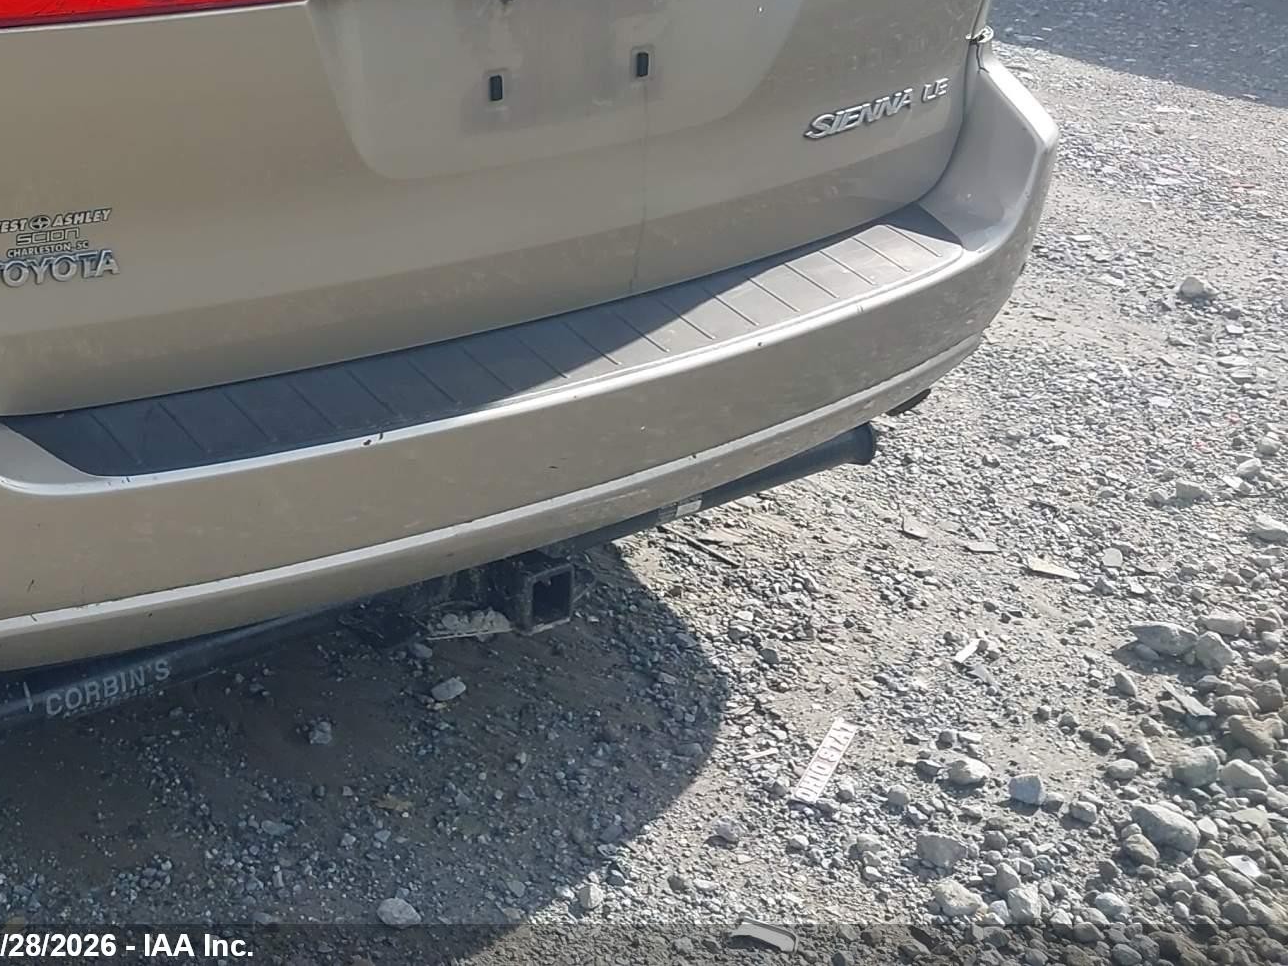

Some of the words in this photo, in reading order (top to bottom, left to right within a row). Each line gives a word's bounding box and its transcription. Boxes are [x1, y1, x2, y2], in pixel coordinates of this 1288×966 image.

[804, 88, 913, 139] SIENNA
[921, 77, 949, 103] LE
[51, 208, 112, 228] ASHLEY
[75, 240, 89, 251] SC
[45, 659, 172, 717] CORBIN'S
